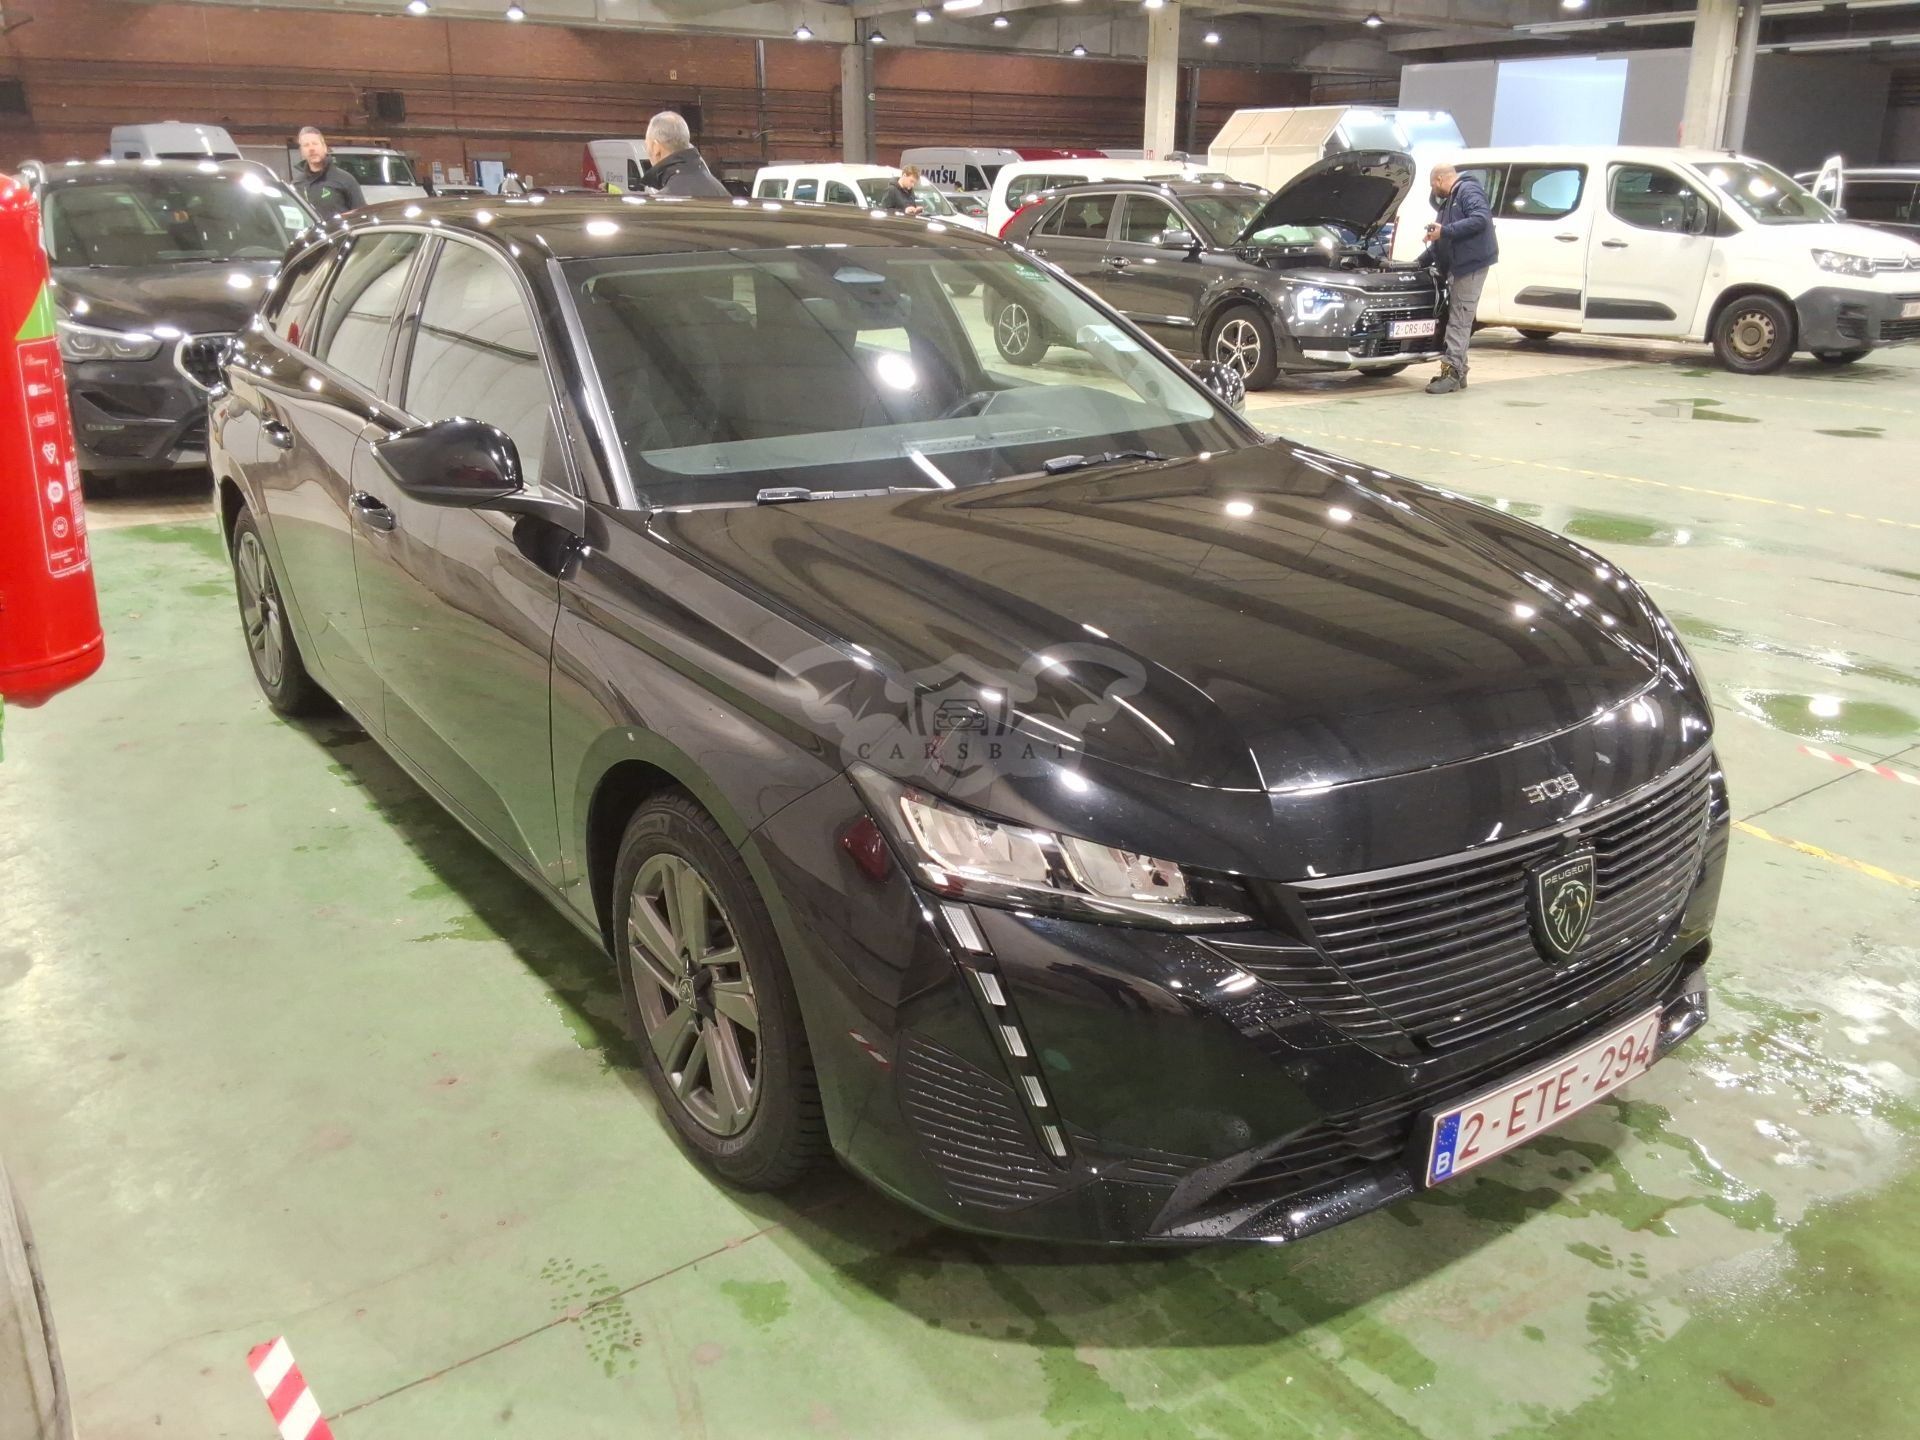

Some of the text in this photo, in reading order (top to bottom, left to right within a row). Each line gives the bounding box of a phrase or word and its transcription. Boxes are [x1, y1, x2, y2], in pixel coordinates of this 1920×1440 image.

[921, 165, 956, 184] MATSU
[1521, 773, 1580, 804] 308
[1544, 863, 1590, 888] PEUGEOT
[1435, 1022, 1655, 1175] B 2-ETE-294
